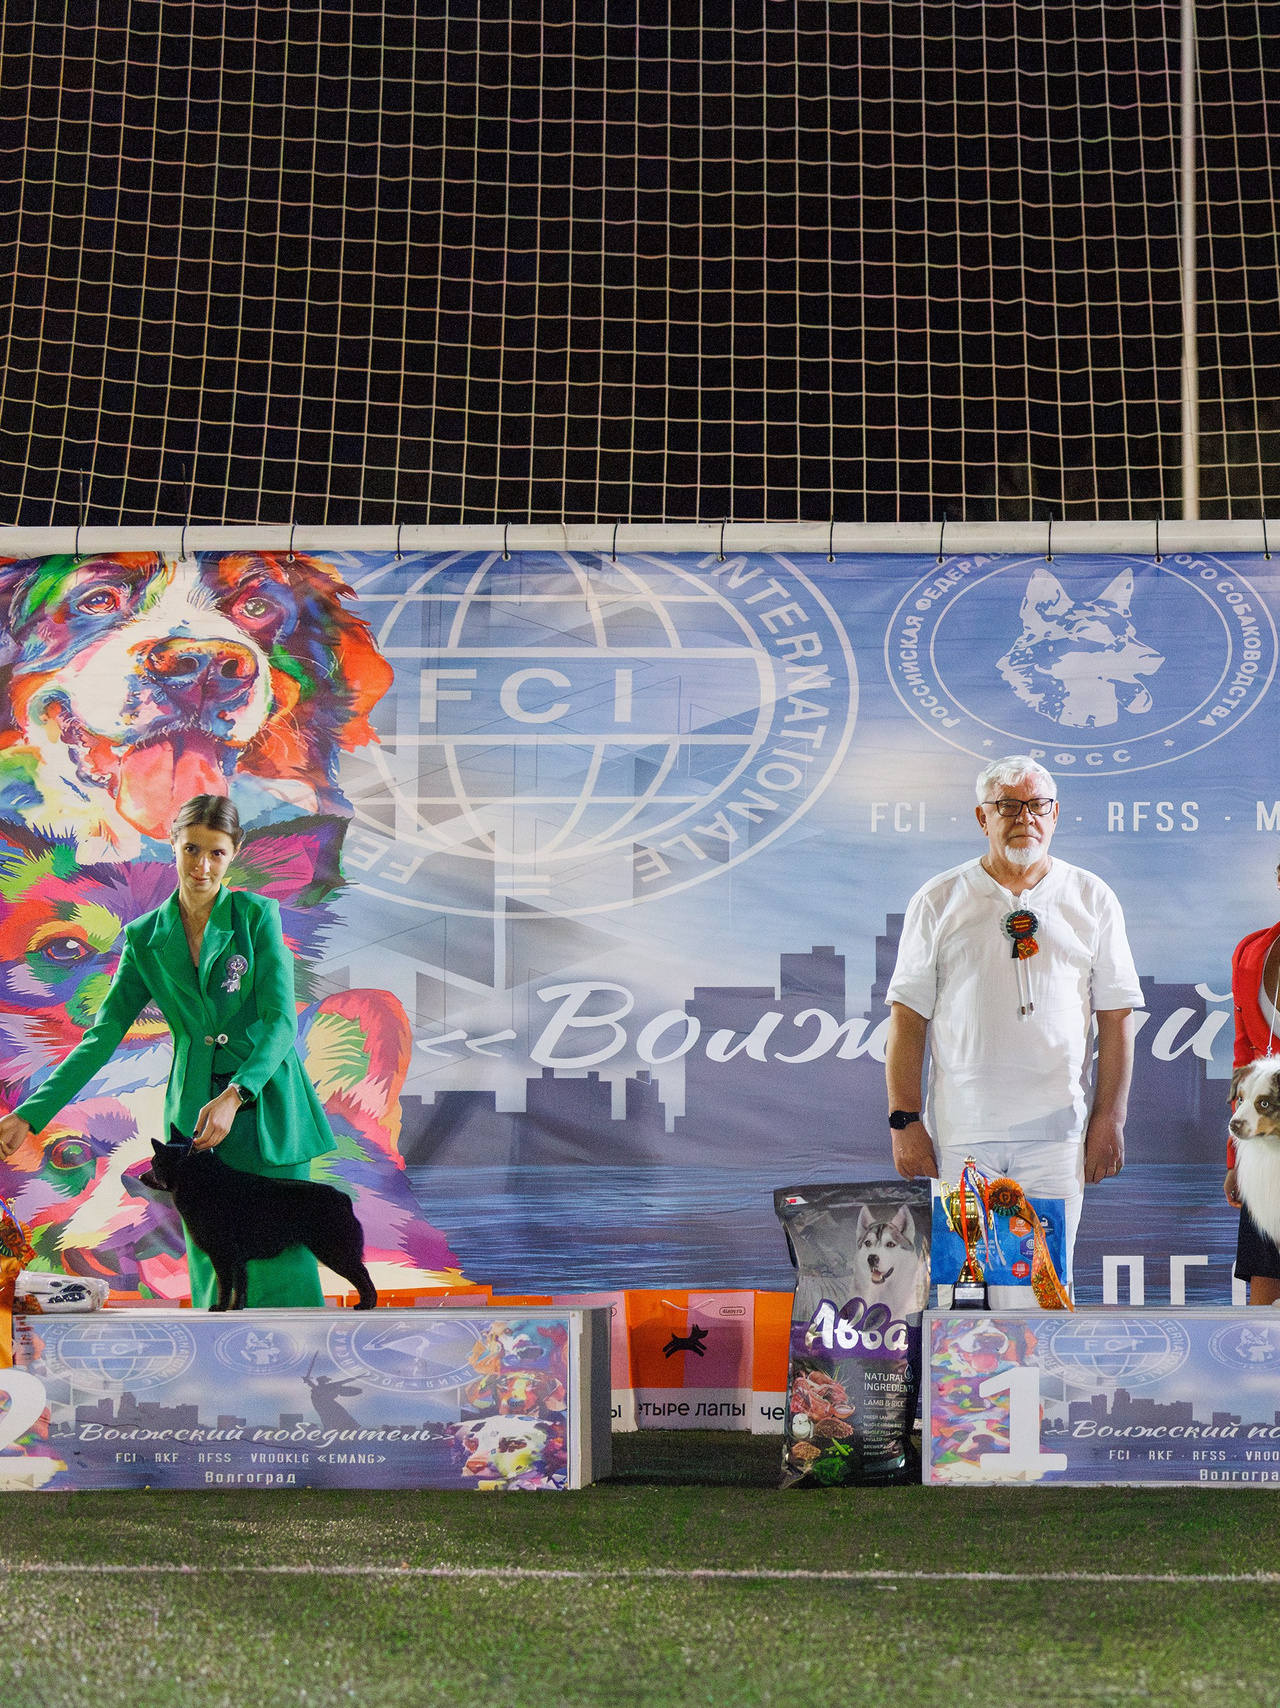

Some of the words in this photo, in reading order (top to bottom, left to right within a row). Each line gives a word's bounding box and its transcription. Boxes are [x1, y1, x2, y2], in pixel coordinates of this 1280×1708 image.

[1197, 577, 1262, 728] СОБАКОВОДСТВА
[419, 668, 634, 725] FCI
[698, 553, 836, 883] INTERNATIONALE
[1028, 748, 1131, 766] РФСС
[870, 802, 926, 832] FCI
[1107, 802, 1199, 832] RFSS
[864, 1372, 905, 1382] NATURAL
[639, 1402, 690, 1416] тыре
[695, 1402, 746, 1416] лапы
[979, 1367, 1067, 1471] 1
[0, 1368, 56, 1475] 2
[1044, 1420, 1242, 1439] «Волжский
[51, 1423, 244, 1442] «Волжский
[252, 1422, 455, 1448] победитель»
[115, 1452, 137, 1464] FCI
[155, 1452, 179, 1464] RKF
[198, 1452, 232, 1464] RFSS
[250, 1452, 309, 1464] VROOKLG
[317, 1453, 387, 1464] «EMANG»
[1109, 1450, 1130, 1461] FCI
[1148, 1450, 1173, 1461] RKF
[1192, 1450, 1226, 1461] RFSS
[205, 1471, 296, 1485] Волгоград
